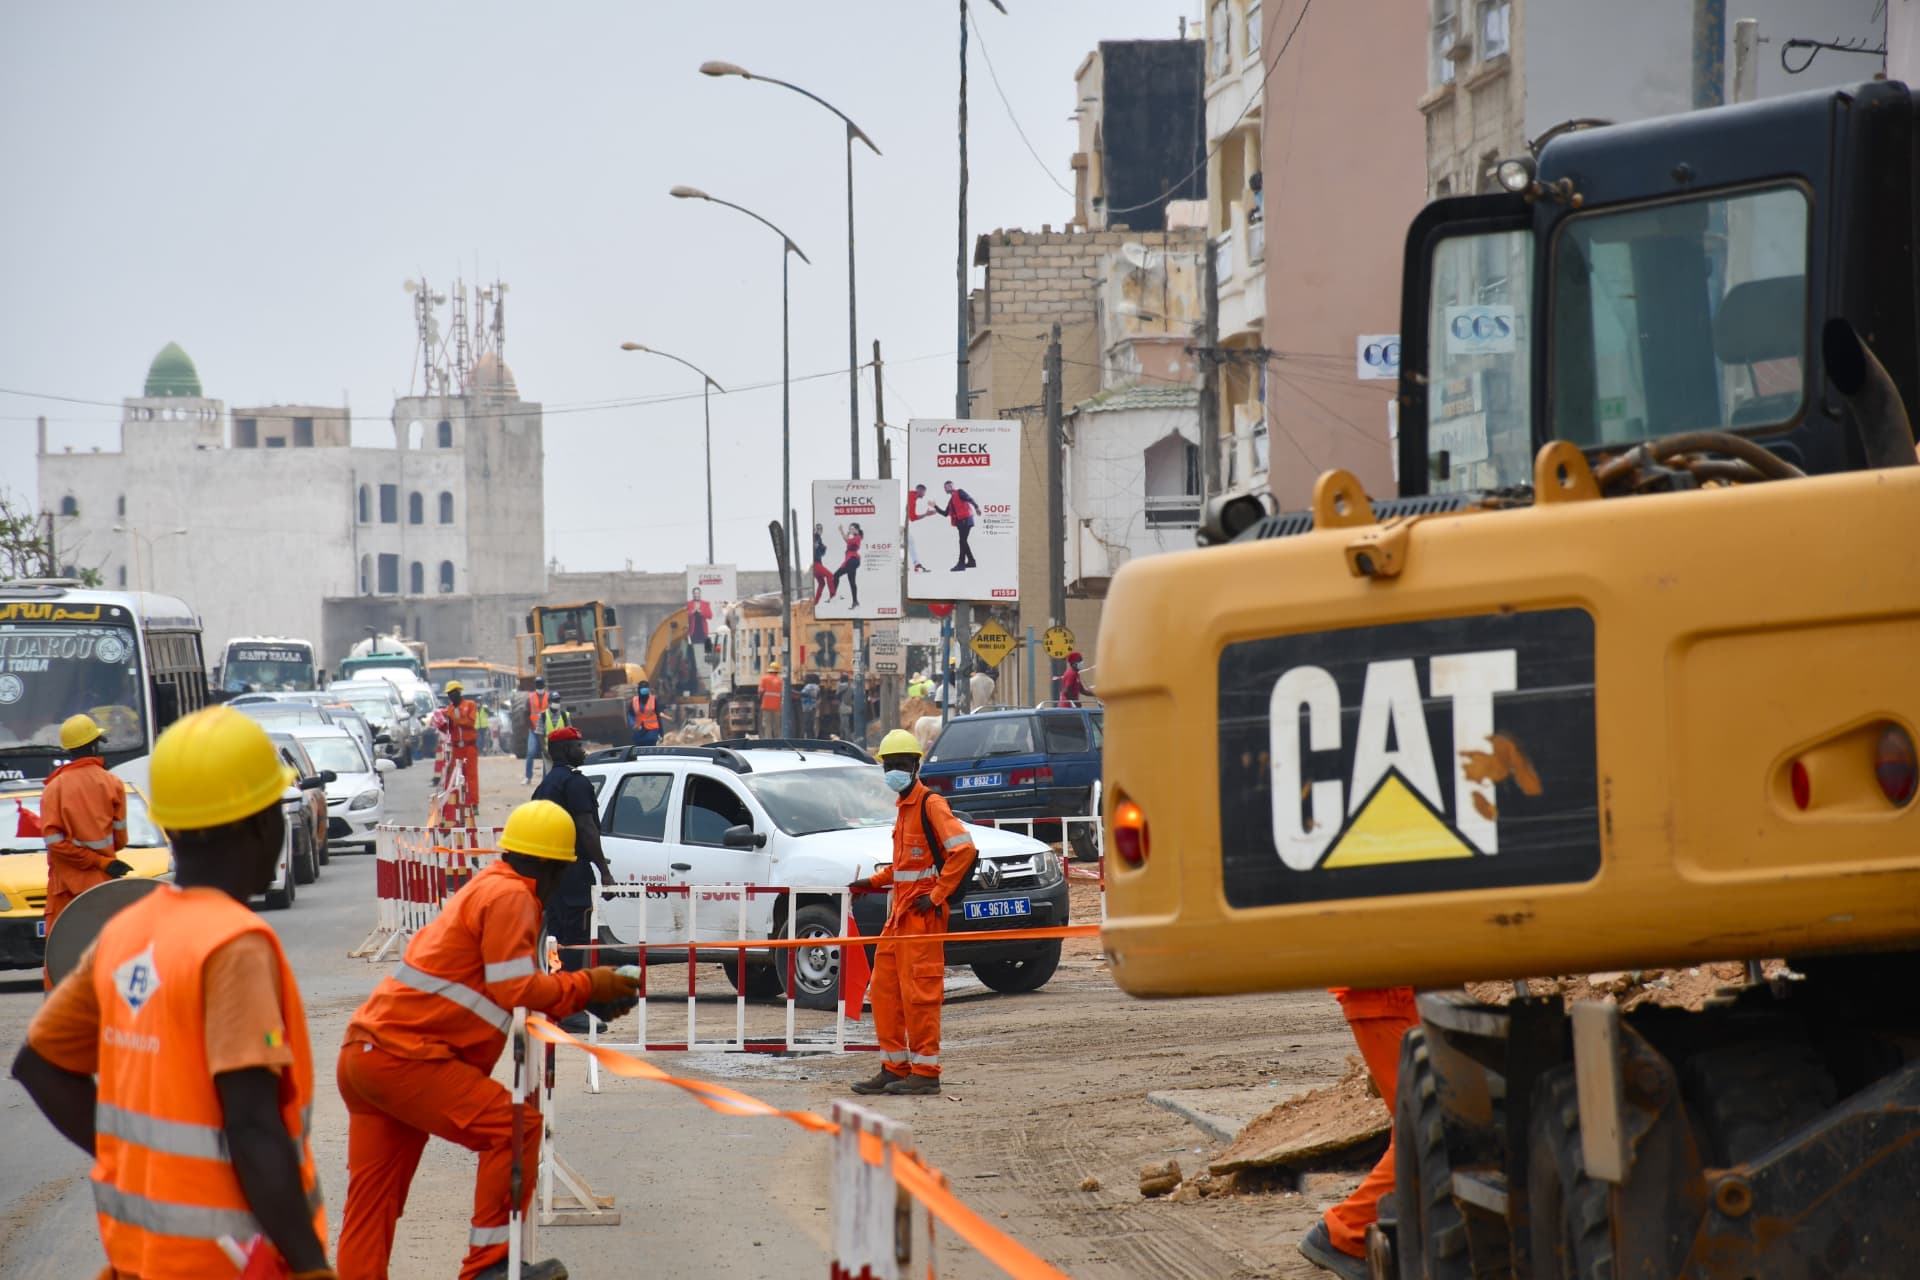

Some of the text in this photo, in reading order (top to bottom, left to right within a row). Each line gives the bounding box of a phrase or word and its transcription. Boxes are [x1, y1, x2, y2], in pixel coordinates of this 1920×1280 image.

[1363, 343, 1401, 366] CG
[938, 424, 969, 437] free
[938, 443, 988, 454] CHECK
[938, 456, 988, 466] GRAAAVE
[834, 496, 874, 505] CHECK
[983, 504, 1011, 513] 500F
[977, 634, 1008, 642] ARRET
[8, 637, 96, 659] DAROU
[8, 659, 49, 672] TOUBA
[1269, 648, 1517, 871] CAT
[0, 770, 24, 779] ATA
